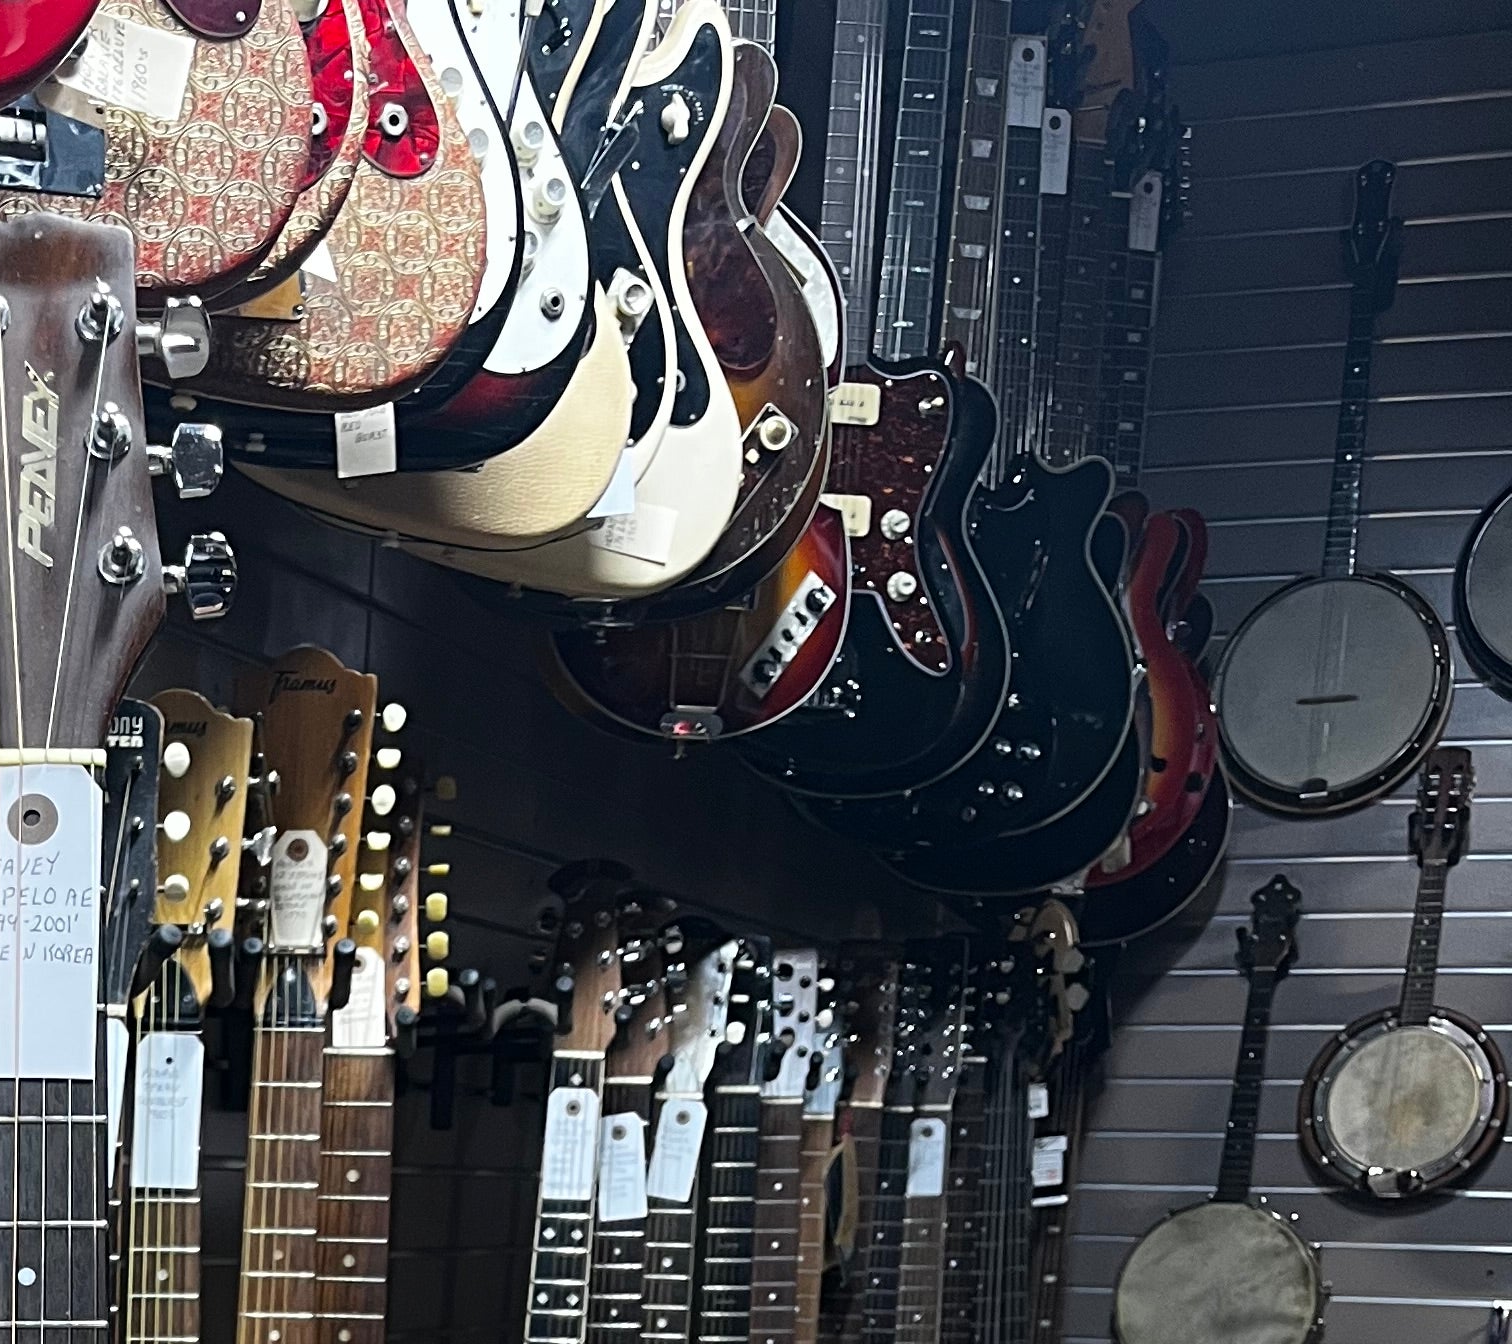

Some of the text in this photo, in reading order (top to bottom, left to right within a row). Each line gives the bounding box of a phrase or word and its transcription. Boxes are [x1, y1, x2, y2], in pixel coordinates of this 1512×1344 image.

[18, 359, 60, 569] PEAVEY
[269, 670, 337, 704] Framus
[65, 887, 93, 908] AE
[43, 943, 94, 965] KOREA
